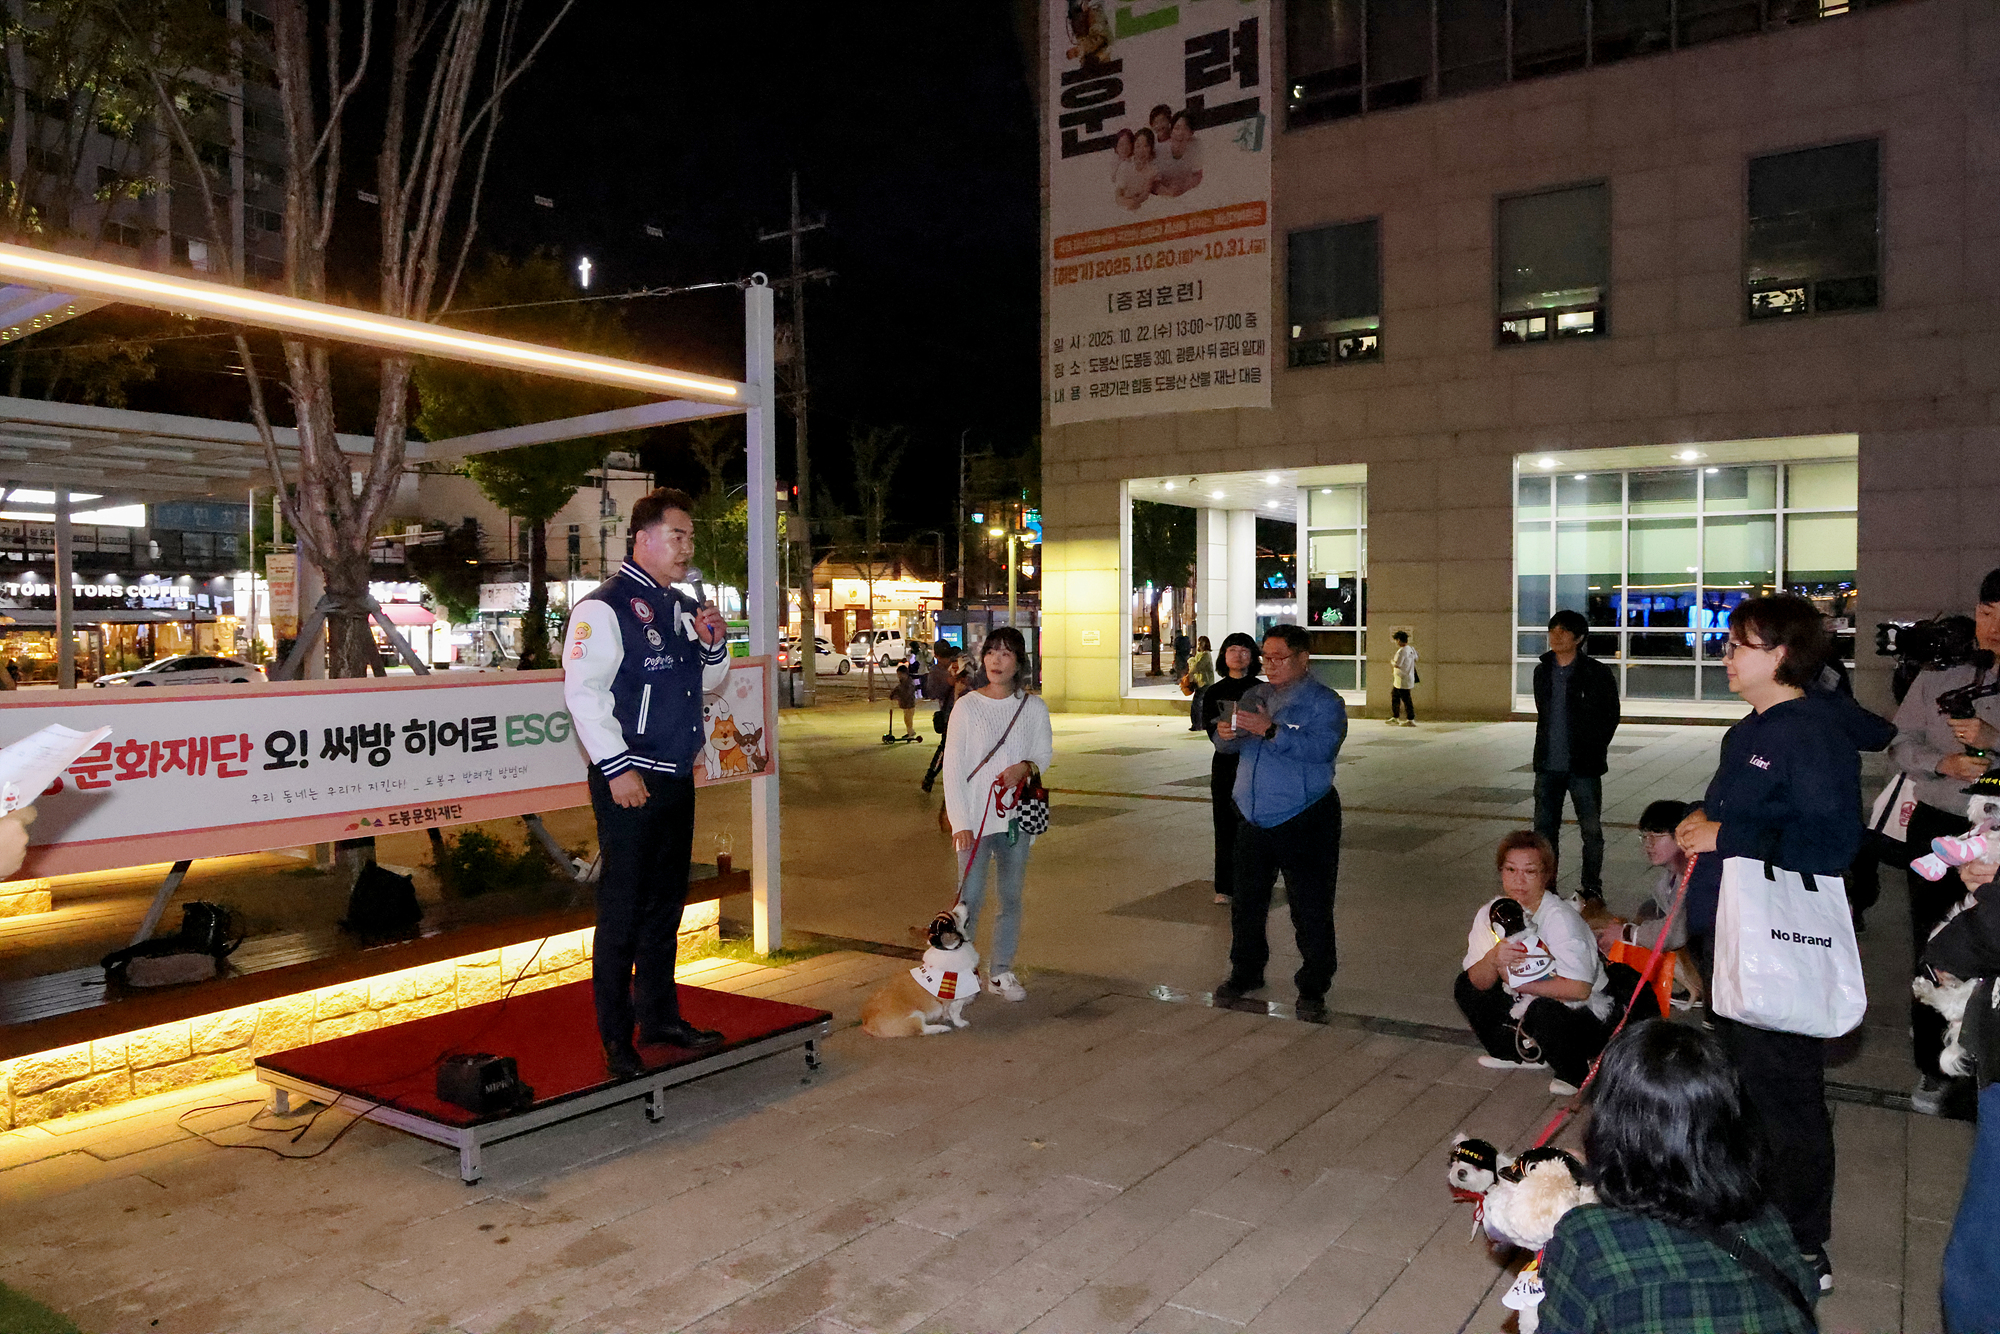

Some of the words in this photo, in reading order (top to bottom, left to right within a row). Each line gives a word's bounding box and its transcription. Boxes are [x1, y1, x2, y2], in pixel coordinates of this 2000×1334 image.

[1176, 313, 1242, 336] 13:00~17:00
[1245, 312, 1258, 328] 중
[1053, 363, 1065, 379] 장
[1089, 356, 1119, 374] 도봉산
[1207, 343, 1218, 360] 뒤
[1219, 341, 1240, 359] 공터
[1054, 388, 1065, 404] 내
[1089, 378, 1129, 400] 유관기관
[1131, 375, 1153, 394] 합동
[1155, 373, 1187, 391] 도봉산
[1189, 371, 1211, 389] 산불
[1213, 368, 1236, 386] 재난
[1239, 366, 1263, 384] 대응
[7, 581, 50, 597] TOM
[72, 584, 123, 598] TOMS
[126, 585, 190, 598] COFFEE
[42, 732, 254, 796] 문화재단
[263, 729, 309, 771] 오!
[319, 722, 396, 768] 써방
[402, 715, 499, 757] 히어로
[505, 711, 571, 748] ESG
[250, 792, 275, 805] 우리
[283, 787, 319, 805] 동네는
[327, 780, 362, 796] 우리가
[368, 778, 407, 793] 지킨다!
[425, 773, 457, 788] 도봉구
[462, 769, 494, 785] 반려견
[498, 765, 529, 781] 방범대
[387, 803, 463, 827] 도봉문화재단
[1771, 928, 1790, 942] No
[1792, 932, 1832, 948] Brand
